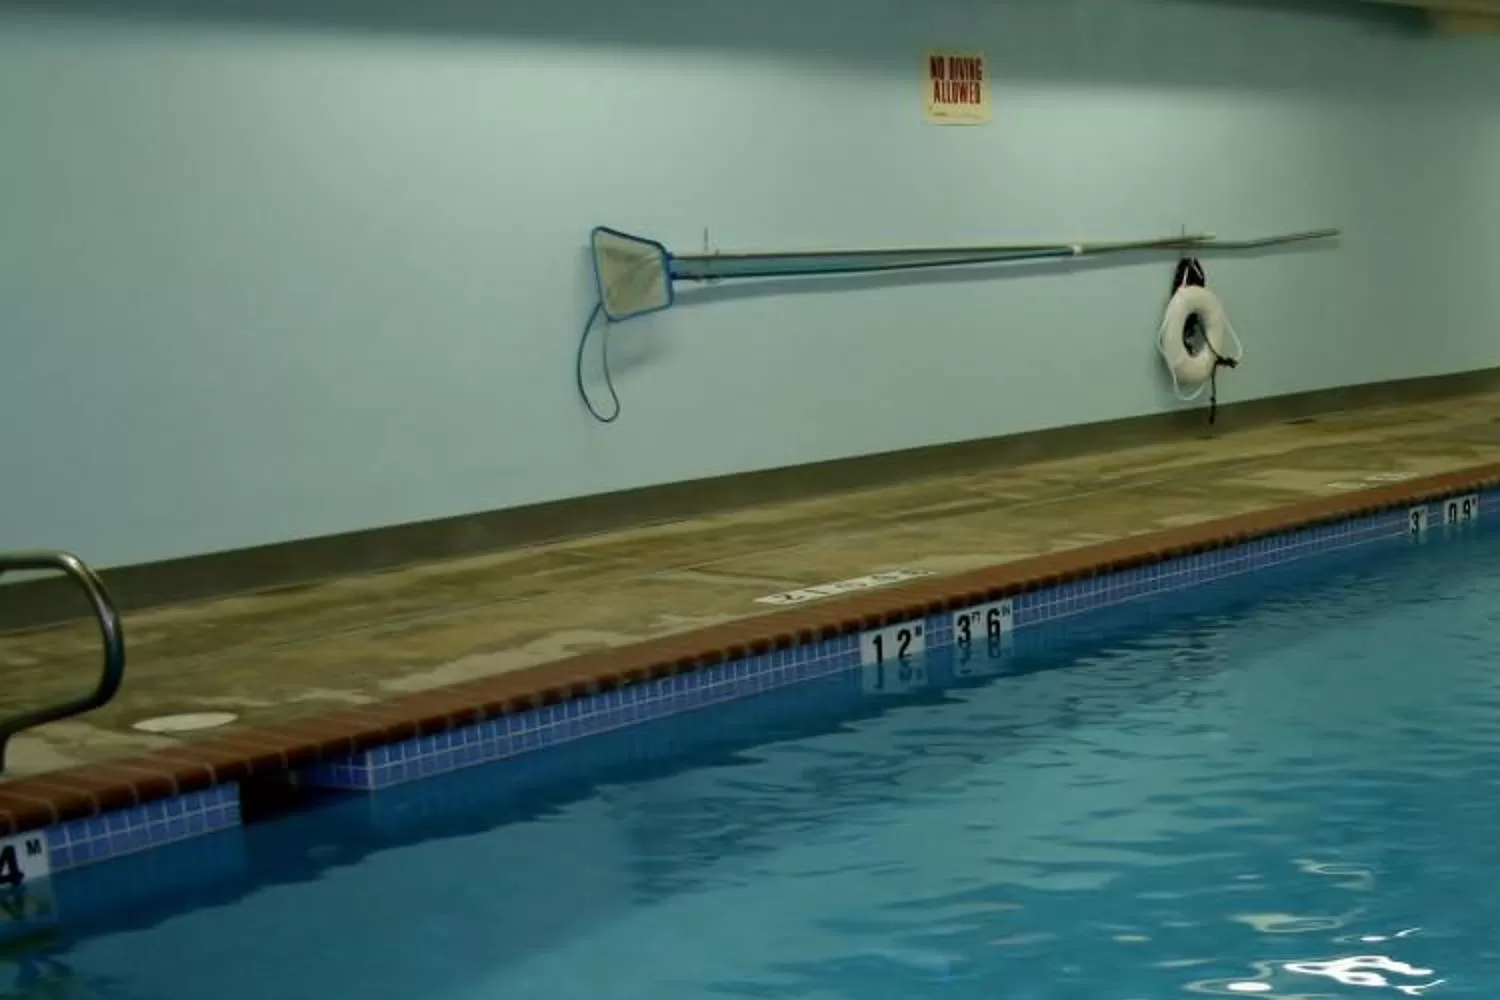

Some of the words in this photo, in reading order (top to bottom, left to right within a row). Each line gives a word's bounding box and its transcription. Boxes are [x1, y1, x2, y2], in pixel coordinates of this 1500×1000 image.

[930, 56, 945, 79] NO
[949, 56, 983, 80] DIVING
[933, 81, 981, 104] ALLOWED
